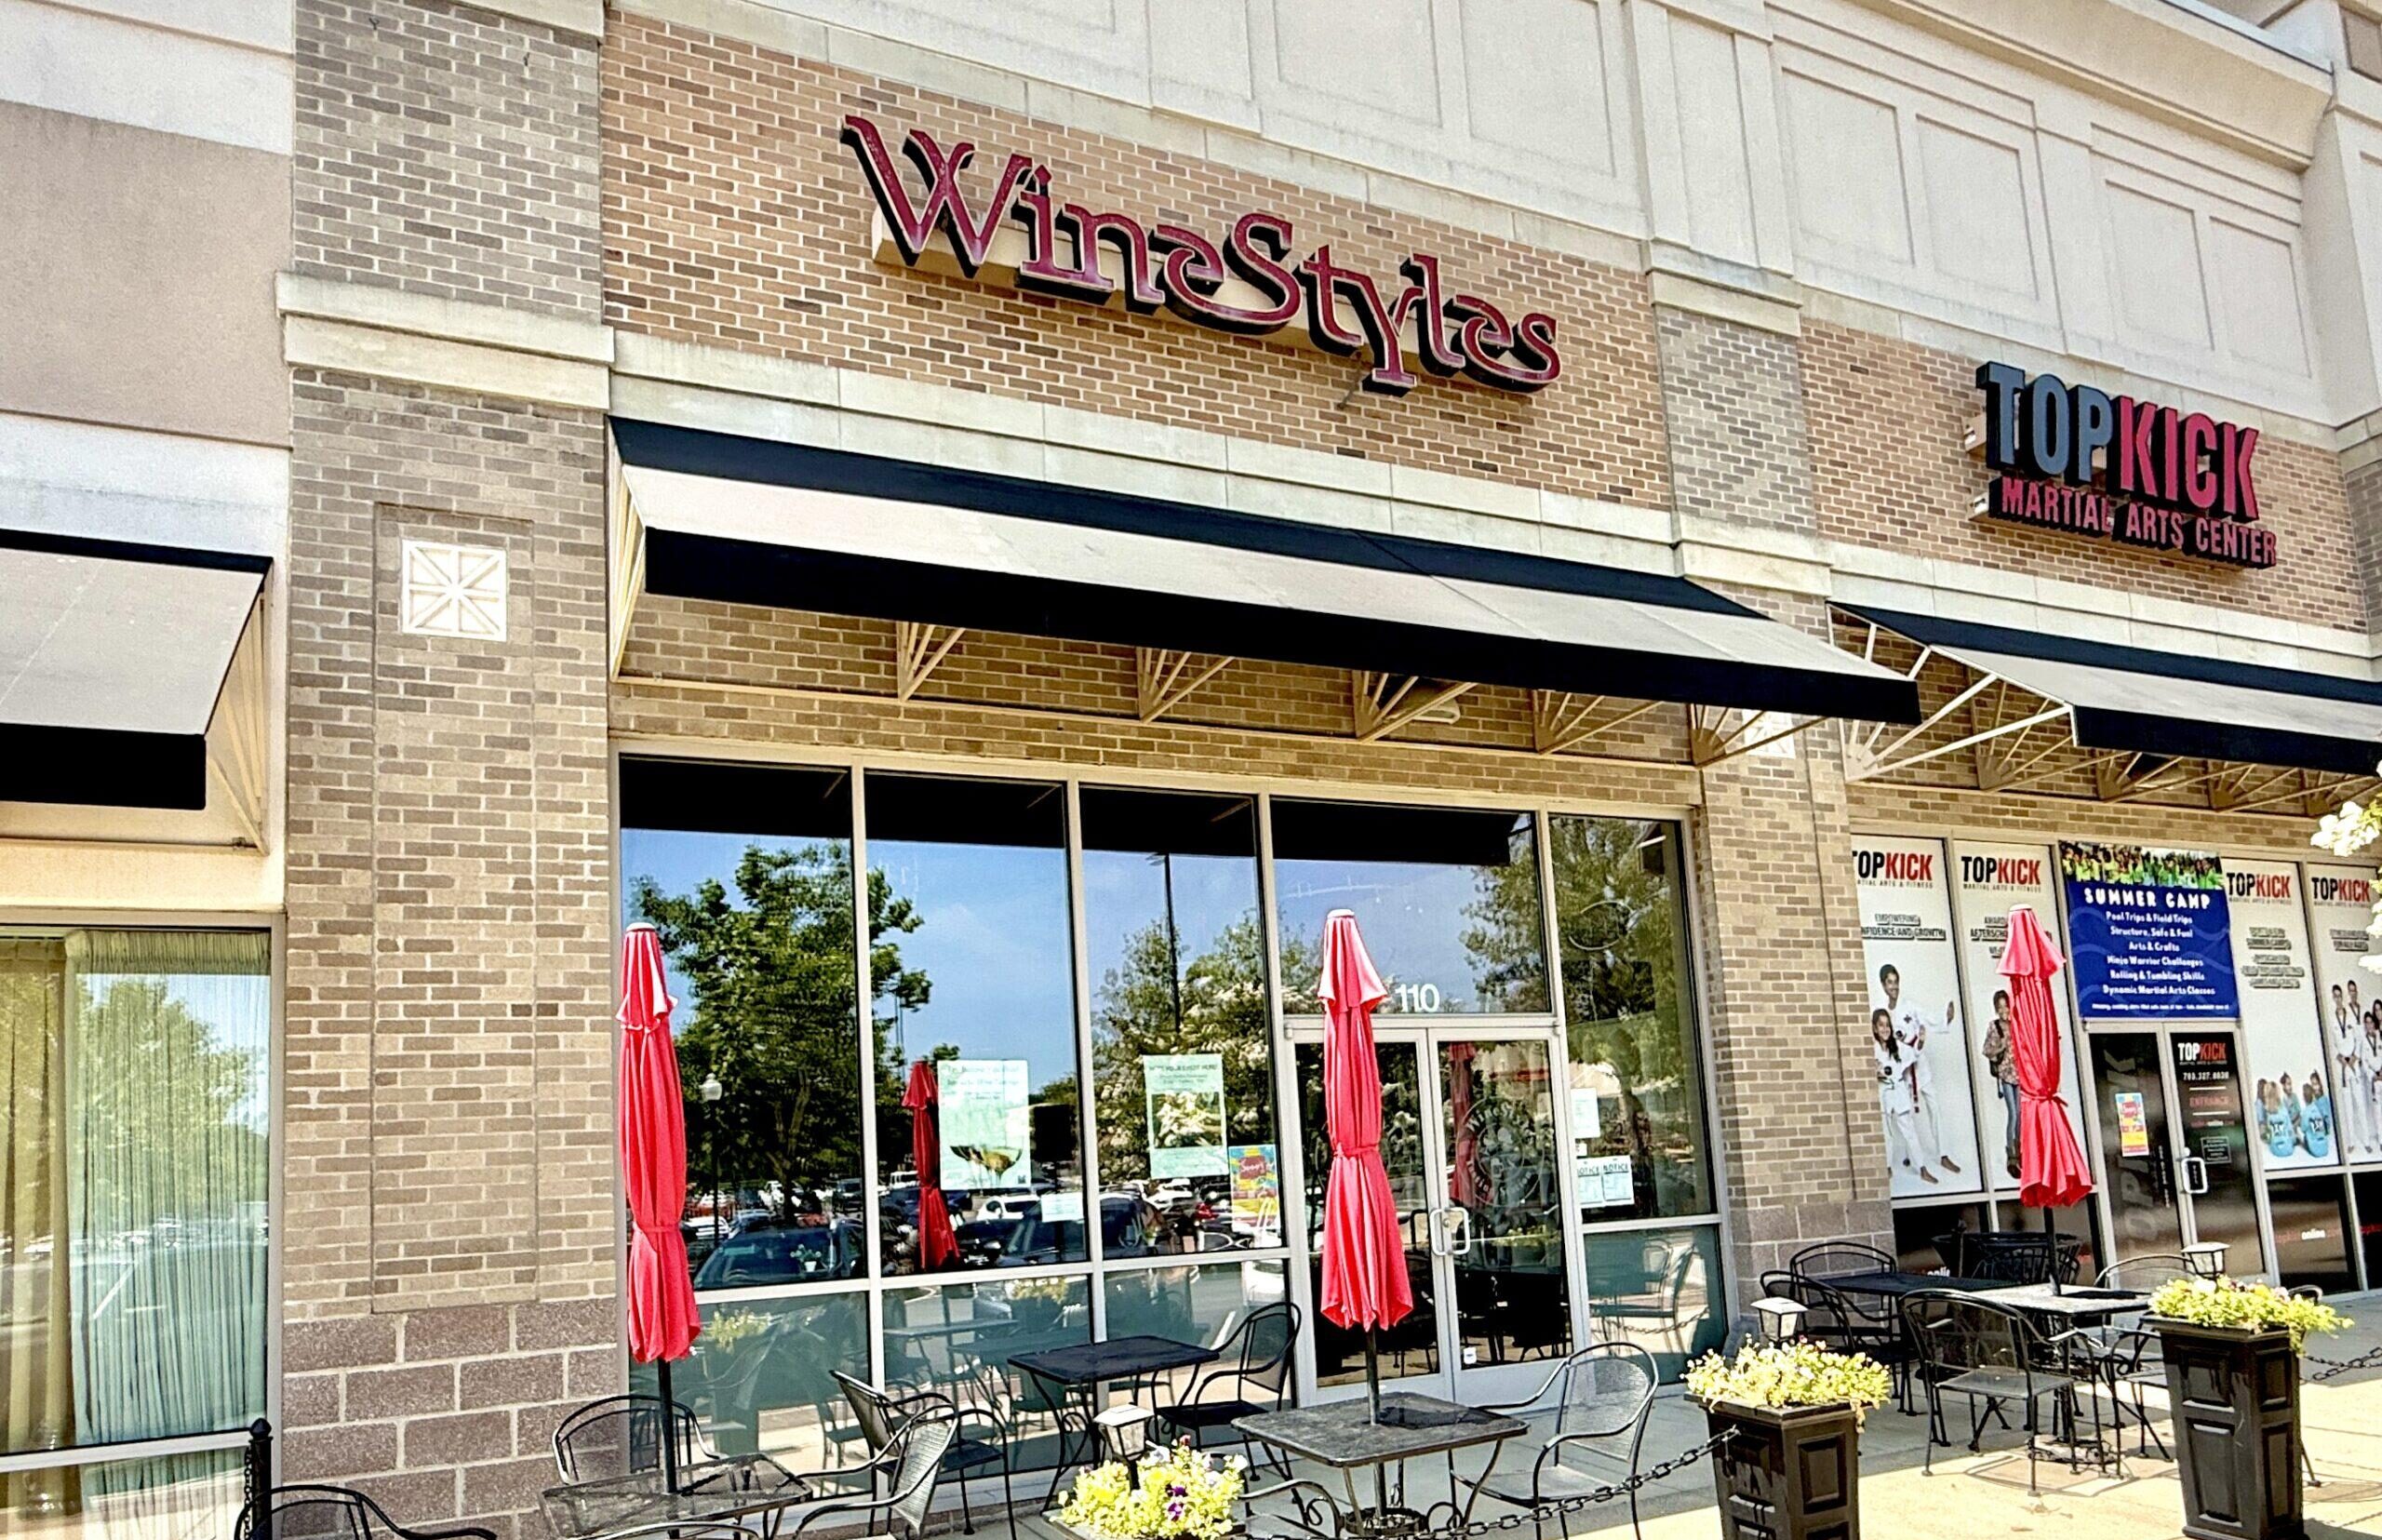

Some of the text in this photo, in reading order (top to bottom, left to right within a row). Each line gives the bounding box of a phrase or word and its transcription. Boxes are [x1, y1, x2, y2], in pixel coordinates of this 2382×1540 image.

[842, 114, 1559, 394] WineStyles
[1979, 361, 2259, 519] TOPKICK
[1999, 475, 2277, 568] MARTIAL ARTS CENTER
[1961, 856, 2041, 885] TOPKICK
[2227, 873, 2291, 899] TOPKICK
[2311, 877, 2371, 903] TOPKICK
[2084, 888, 2211, 910] SUMMER CAMP
[2106, 911, 2193, 926] Pool Trips & Field Trips
[1898, 928, 1912, 937] AND
[1914, 928, 1946, 939] GROWTH
[2151, 928, 2169, 937] Safe
[2170, 929, 2175, 937] &
[2177, 929, 2193, 938] Fun!
[2129, 942, 2180, 952] Arts & Crafts
[2107, 956, 2203, 968] Ninja Warrior Challenges
[2110, 970, 2205, 982] Rolling & Tumbling Skills
[1396, 984, 1440, 1012] 110
[2103, 984, 2215, 996] Dynamic Martial Arts Classes
[2177, 1042, 2227, 1062] TOPKICK
[1603, 1163, 1628, 1172] NOTICE
